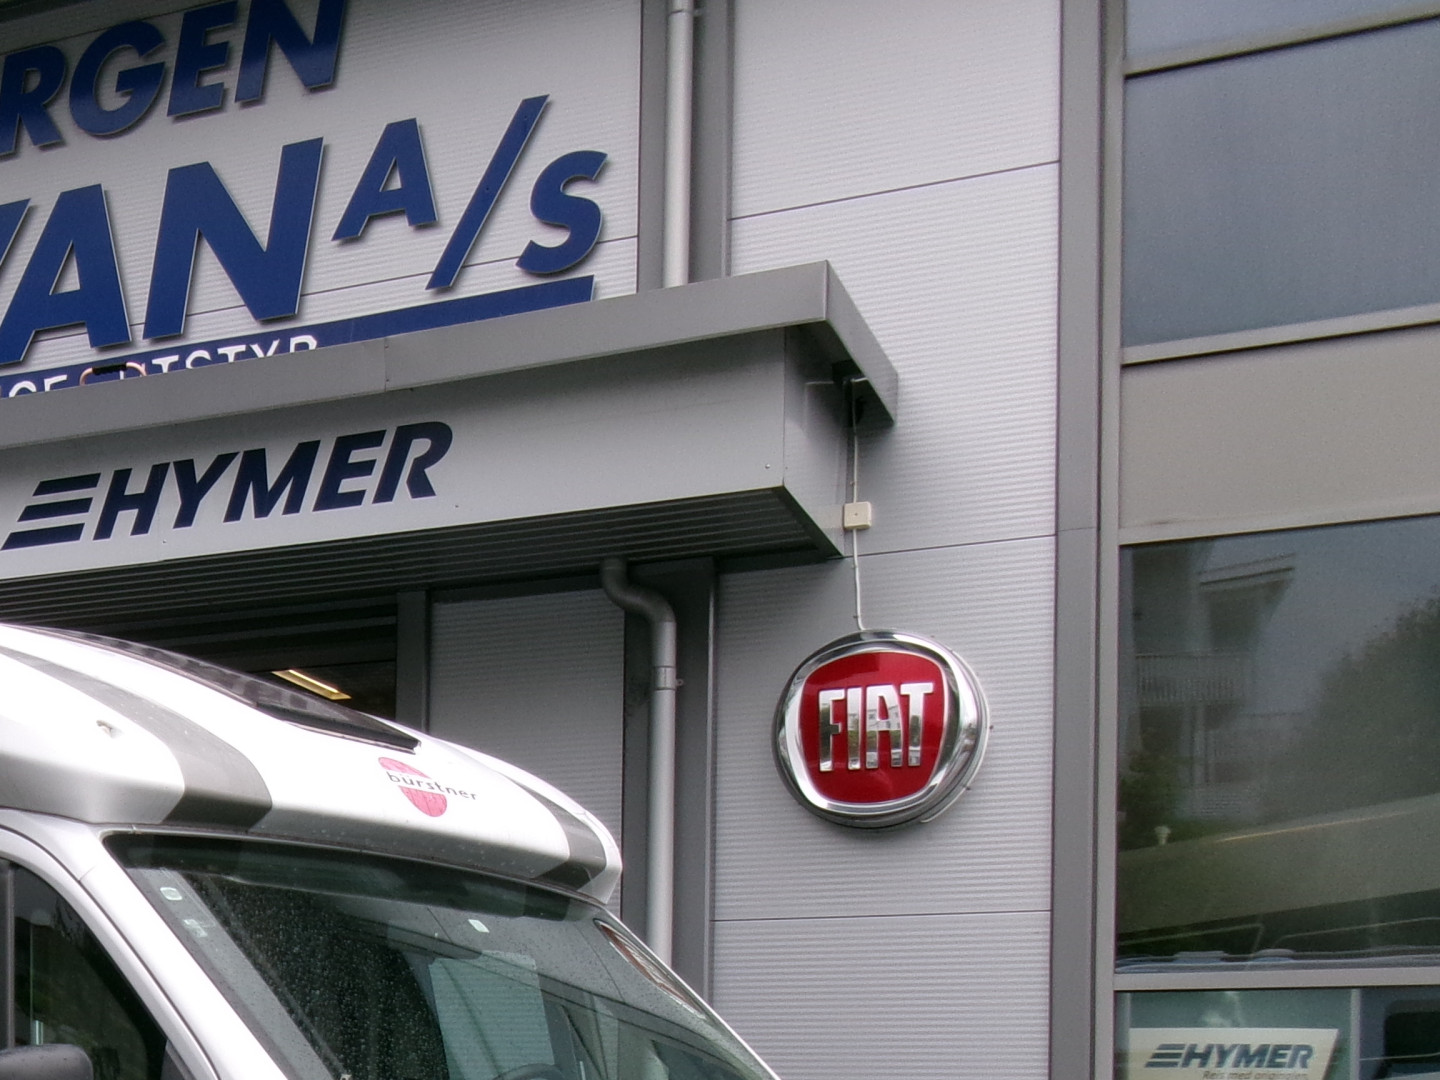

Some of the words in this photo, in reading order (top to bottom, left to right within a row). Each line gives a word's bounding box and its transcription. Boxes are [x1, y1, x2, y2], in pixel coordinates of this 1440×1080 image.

[92, 421, 453, 541] HYMER
[818, 682, 934, 772] FIAT
[1180, 1043, 1314, 1069] HYMER
